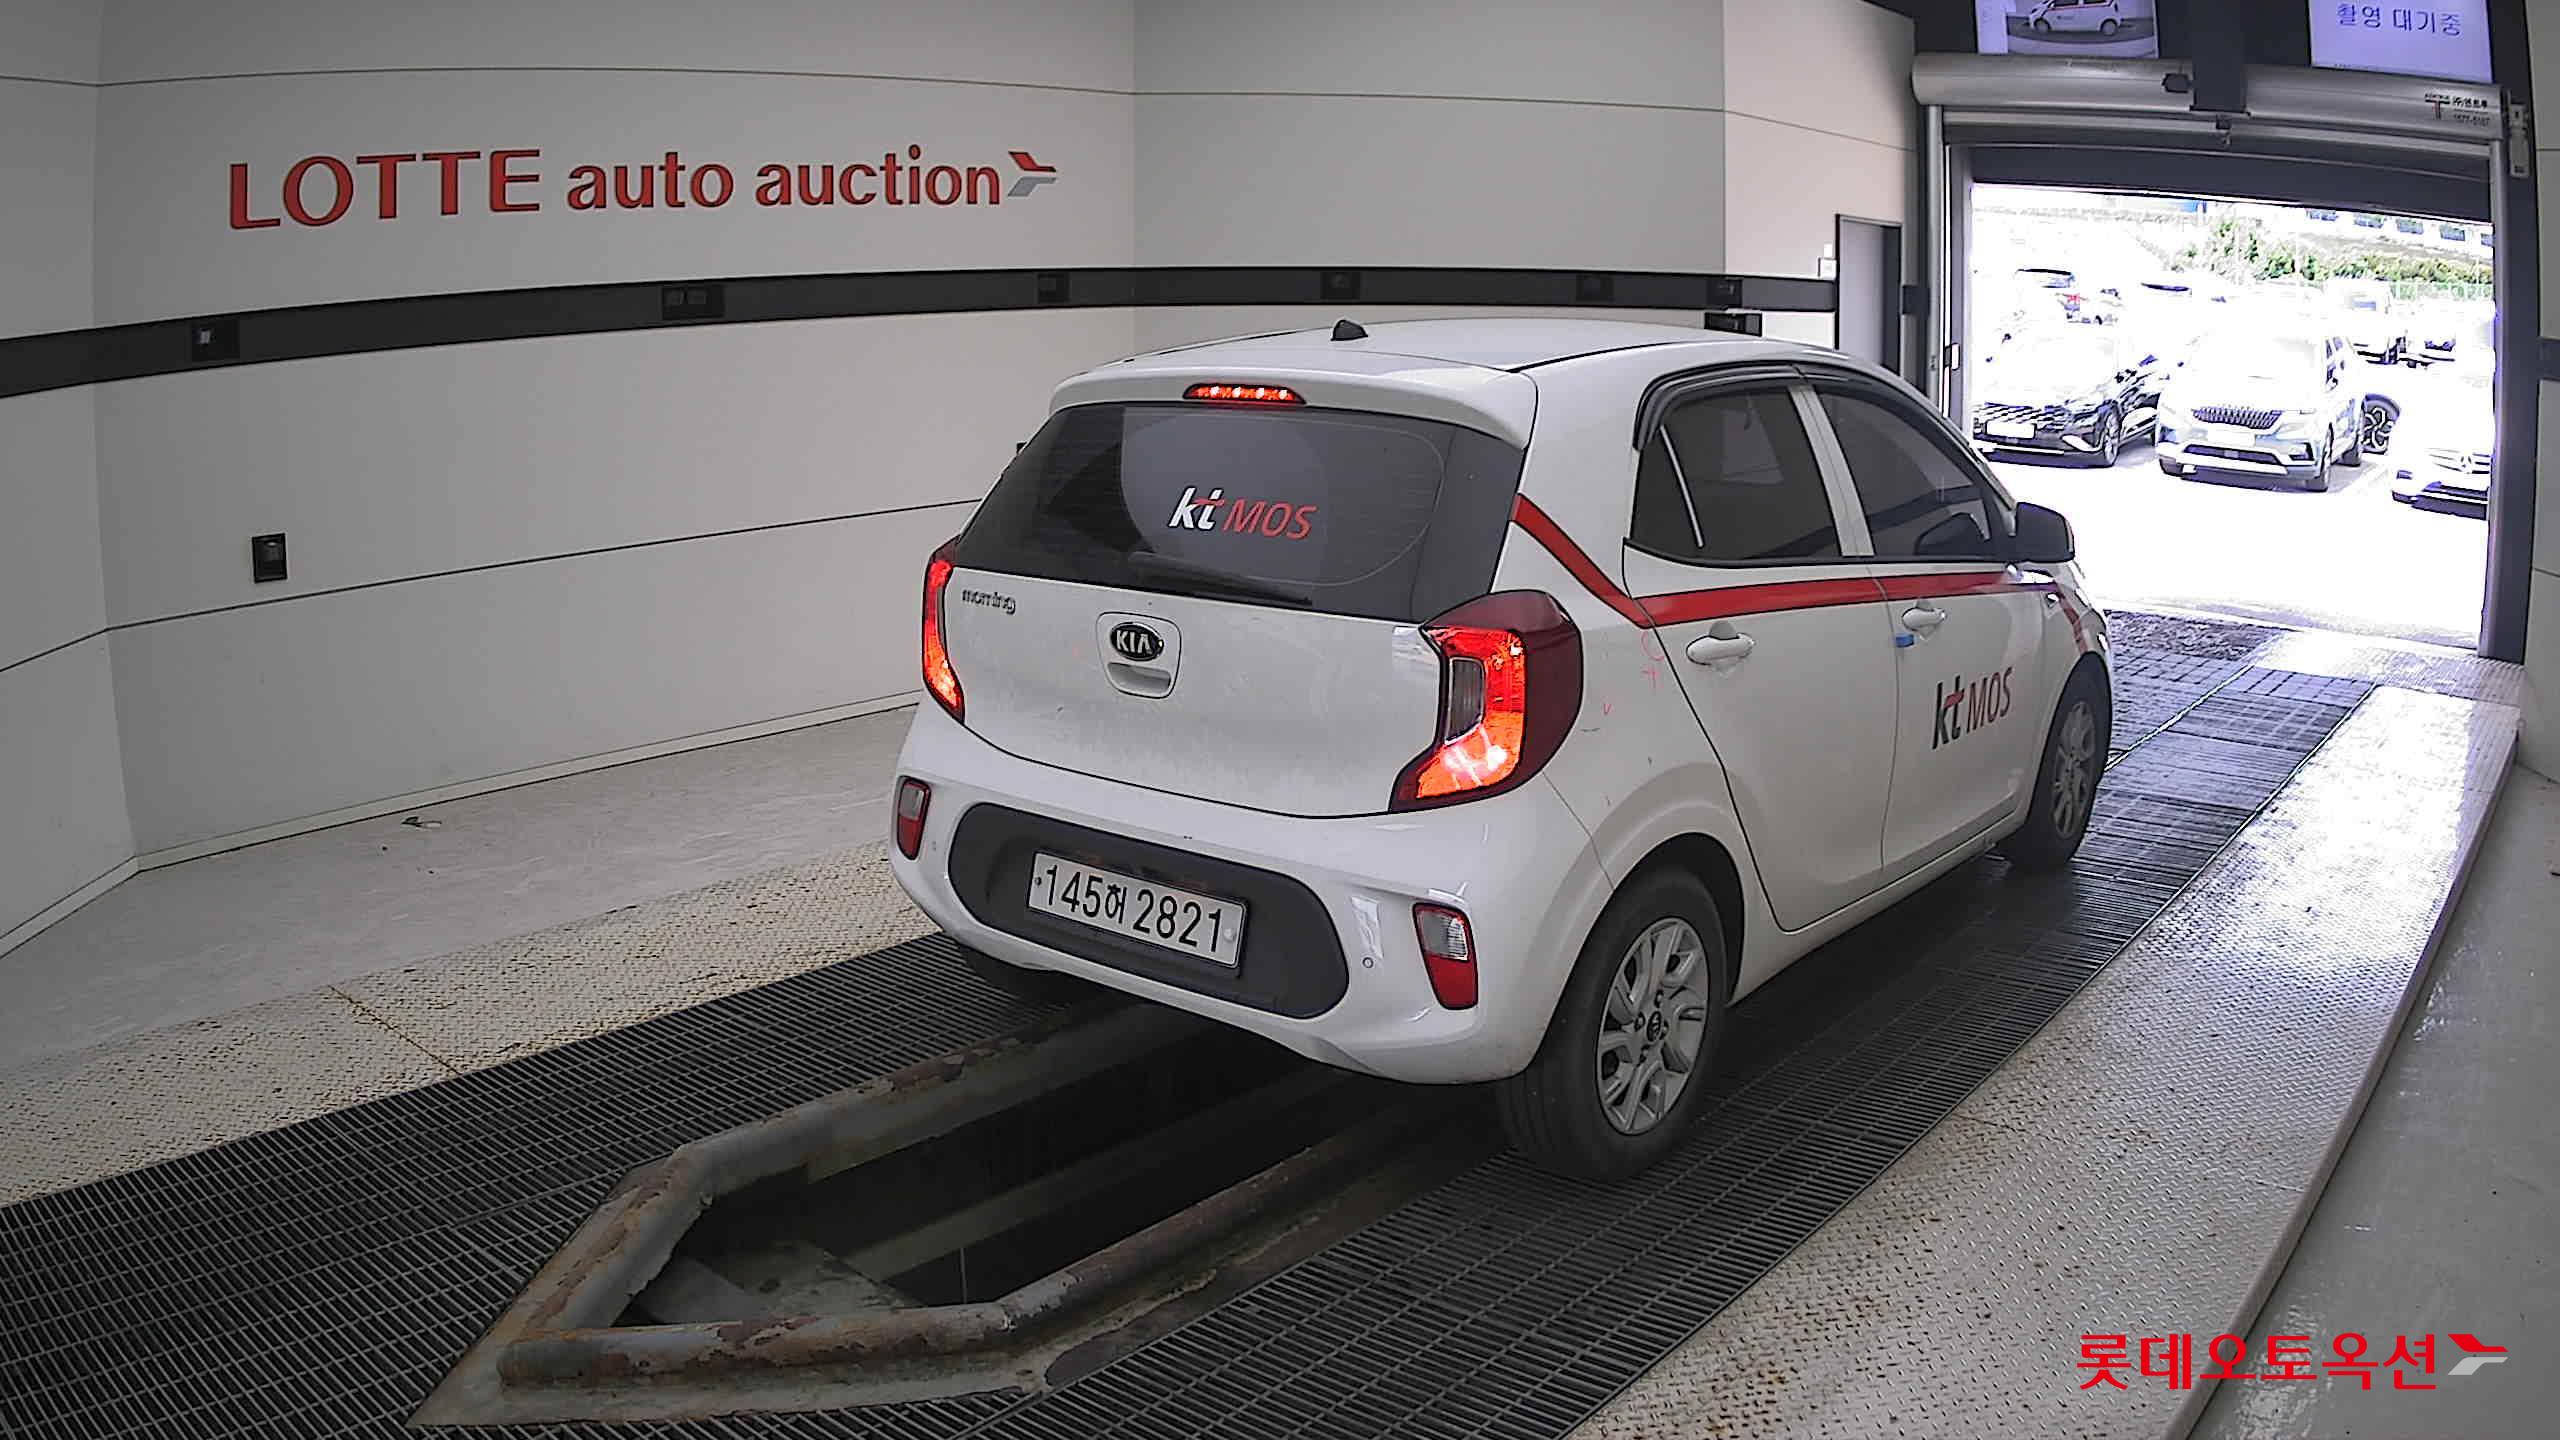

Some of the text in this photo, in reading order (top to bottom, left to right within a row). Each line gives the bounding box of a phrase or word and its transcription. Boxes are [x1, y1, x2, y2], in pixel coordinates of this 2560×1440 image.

[2393, 9, 2461, 36] 대기중
[229, 144, 1000, 230] LOTTE auto auction
[1168, 486, 1318, 540] kt MOS
[962, 589, 1016, 615] morning
[1116, 629, 1153, 654] KIA
[1932, 666, 2013, 750] kt MOS
